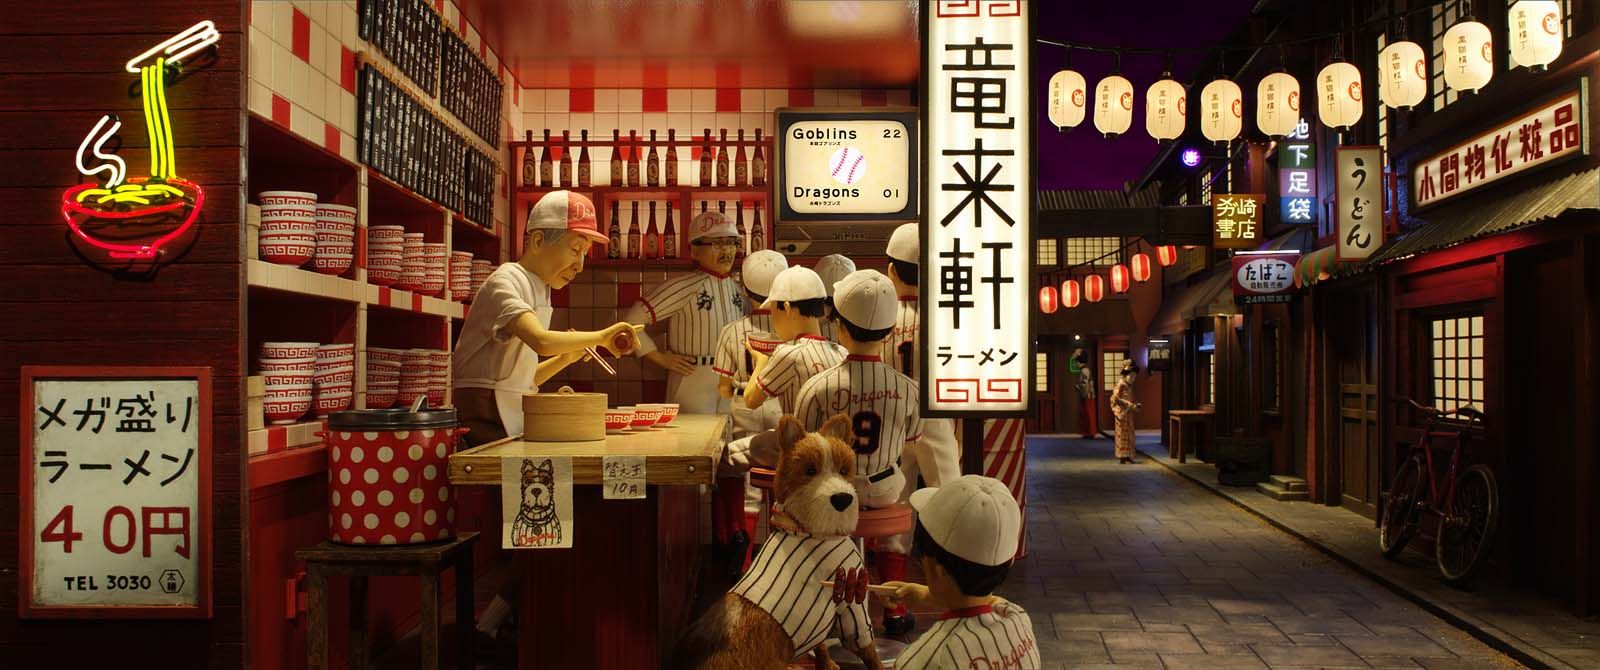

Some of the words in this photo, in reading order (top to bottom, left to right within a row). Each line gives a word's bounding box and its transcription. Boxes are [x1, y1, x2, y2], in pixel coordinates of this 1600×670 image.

[793, 128, 858, 140] Goblins
[883, 129, 901, 138] 22
[1287, 117, 1311, 220] 地下足袋
[1418, 103, 1579, 202] 小間物化粧品
[793, 187, 860, 199] Dragons
[938, 36, 1015, 329] 竜来軒
[1346, 157, 1371, 249] うどん
[1215, 219, 1256, 239] 書店
[1245, 263, 1288, 281] たばこ
[936, 346, 1018, 366] ラーメン
[39, 391, 192, 433] メガ盛り
[832, 387, 902, 411] Dragons
[852, 411, 881, 455] 9
[40, 447, 194, 487] ラーメン
[64, 576, 98, 591] TEL
[106, 575, 152, 591] 3030
